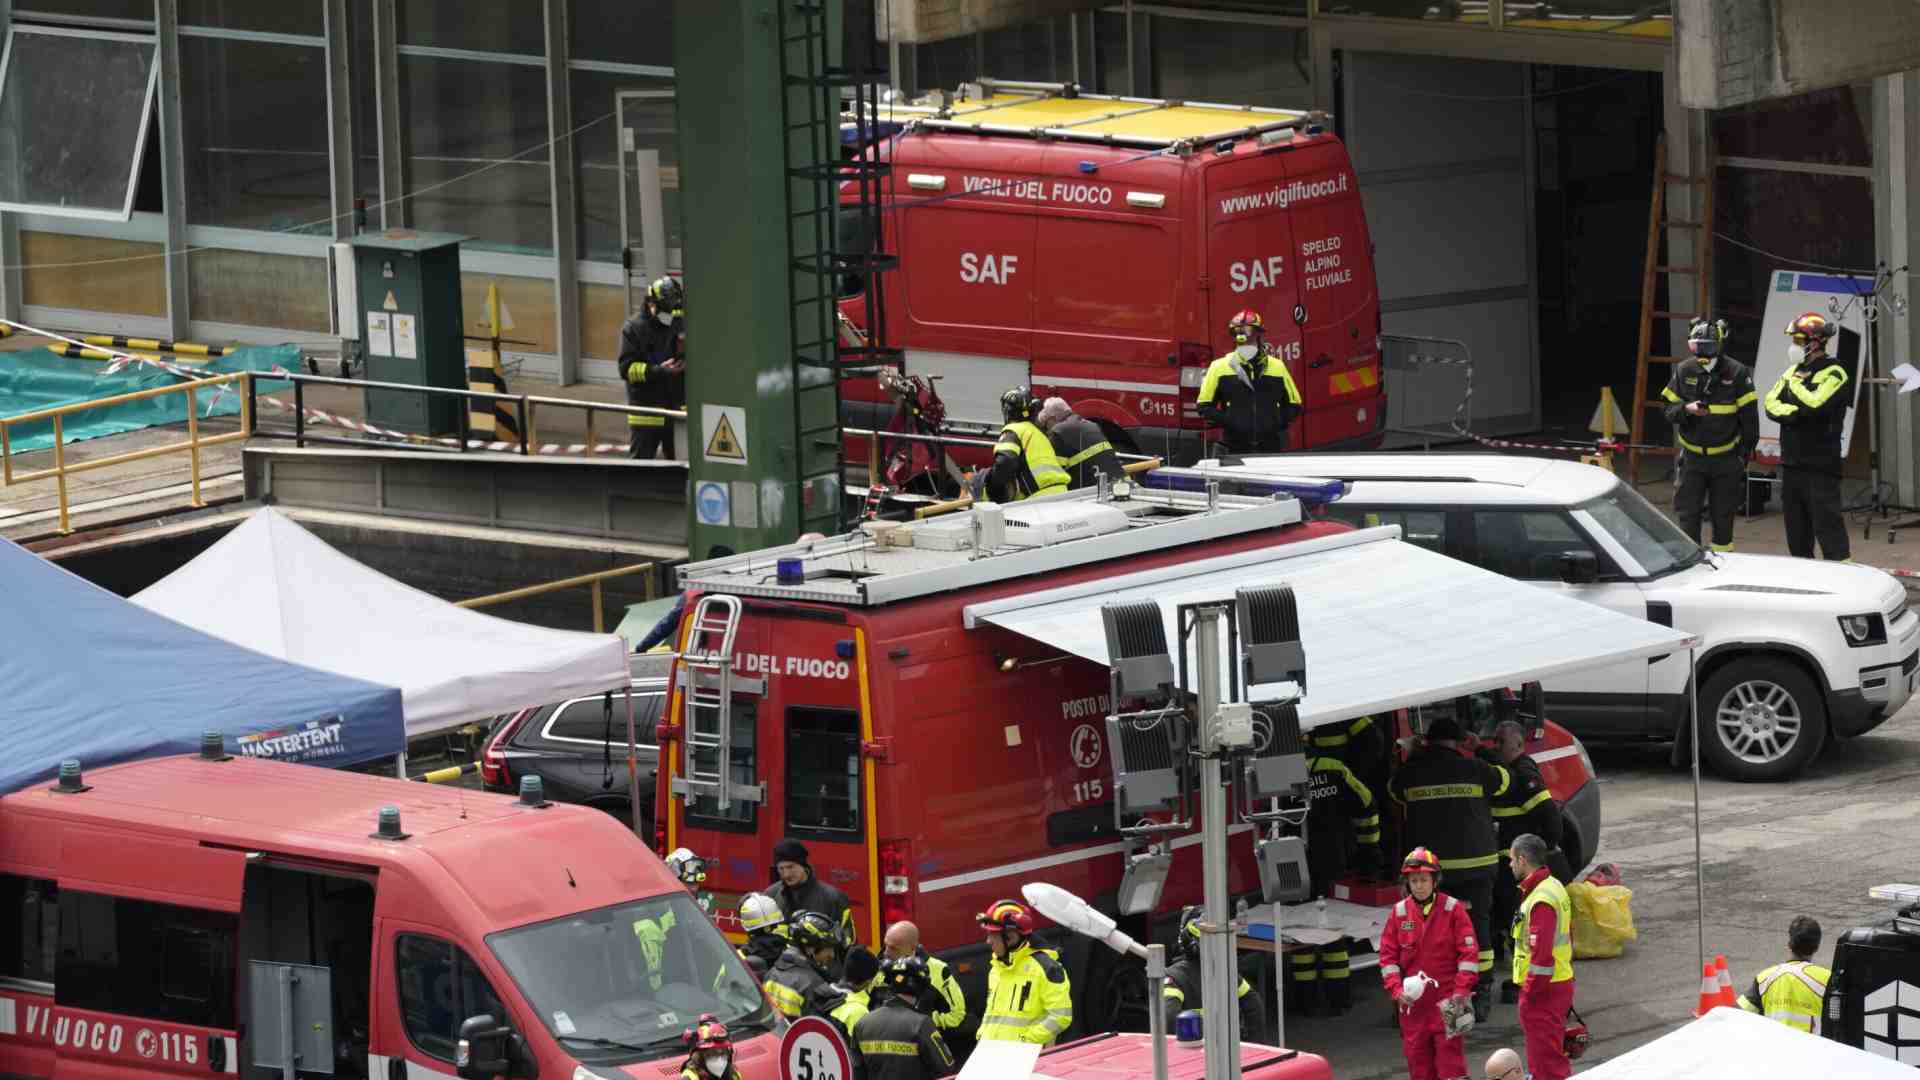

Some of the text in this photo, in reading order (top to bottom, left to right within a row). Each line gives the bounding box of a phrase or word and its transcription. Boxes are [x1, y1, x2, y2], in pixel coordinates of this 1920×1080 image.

[963, 176, 1112, 204] VIGILI DEL FUOCO
[1221, 173, 1347, 213] www.vigilfuoco.it
[1303, 236, 1341, 256] SPELEO
[960, 252, 1018, 285] SAF
[1230, 256, 1283, 292] SAF
[1305, 254, 1340, 273] ALPINO
[1306, 269, 1352, 290] FLUVIALE
[1276, 342, 1300, 360] 115
[1154, 401, 1175, 416] 115
[747, 653, 781, 674] DEL
[786, 657, 849, 679] FUOCO
[1062, 697, 1096, 720] POSTO
[1098, 695, 1110, 712] DI
[240, 723, 342, 757] MASTERTENT
[1073, 779, 1103, 802] 115
[53, 1016, 198, 1064] UOCO 115
[797, 1047, 813, 1080] 5
